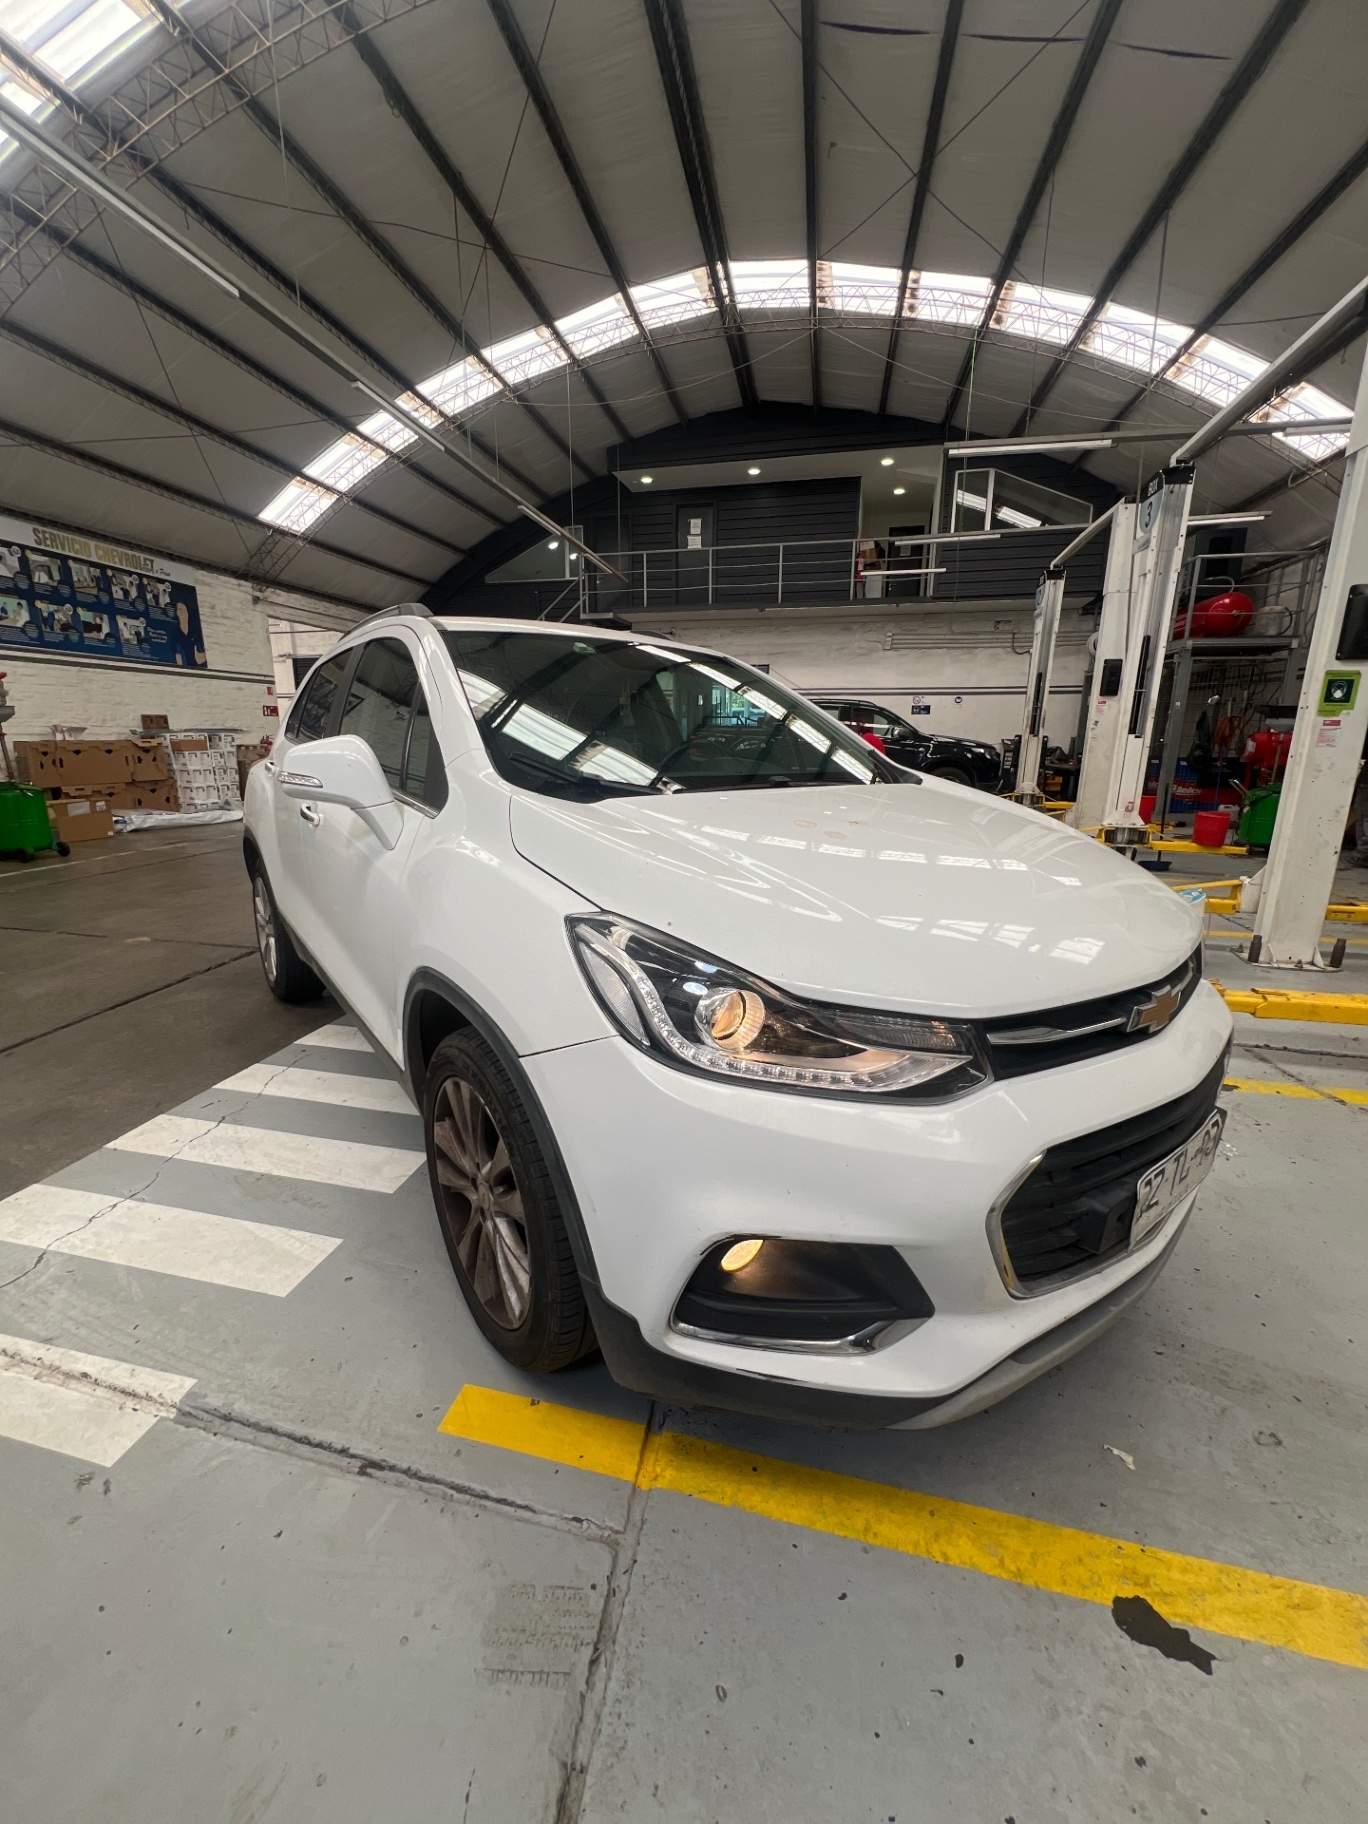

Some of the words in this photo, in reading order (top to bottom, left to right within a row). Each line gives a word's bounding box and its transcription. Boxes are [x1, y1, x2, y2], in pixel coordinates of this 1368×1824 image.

[1145, 501, 1153, 528] 3
[32, 527, 92, 558] SERVICIO
[94, 543, 155, 572] CHEVROLET
